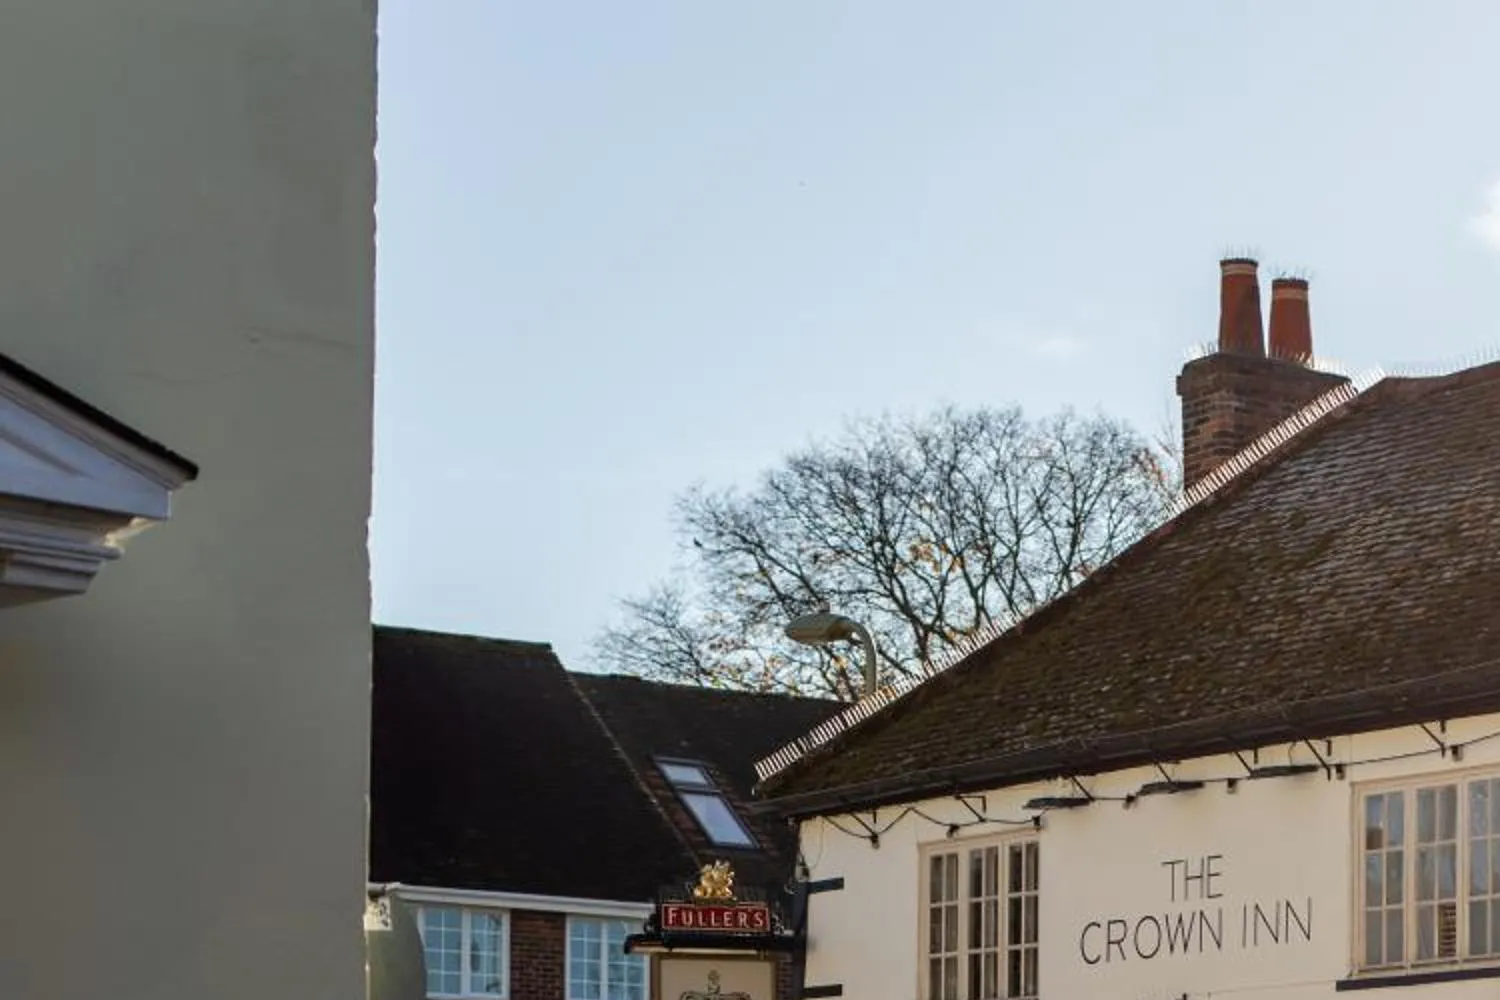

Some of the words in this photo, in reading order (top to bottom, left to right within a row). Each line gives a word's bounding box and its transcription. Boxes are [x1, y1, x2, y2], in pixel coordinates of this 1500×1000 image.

[1161, 854, 1223, 902] THE
[1080, 907, 1223, 965] CROWN
[1242, 896, 1312, 948] INN
